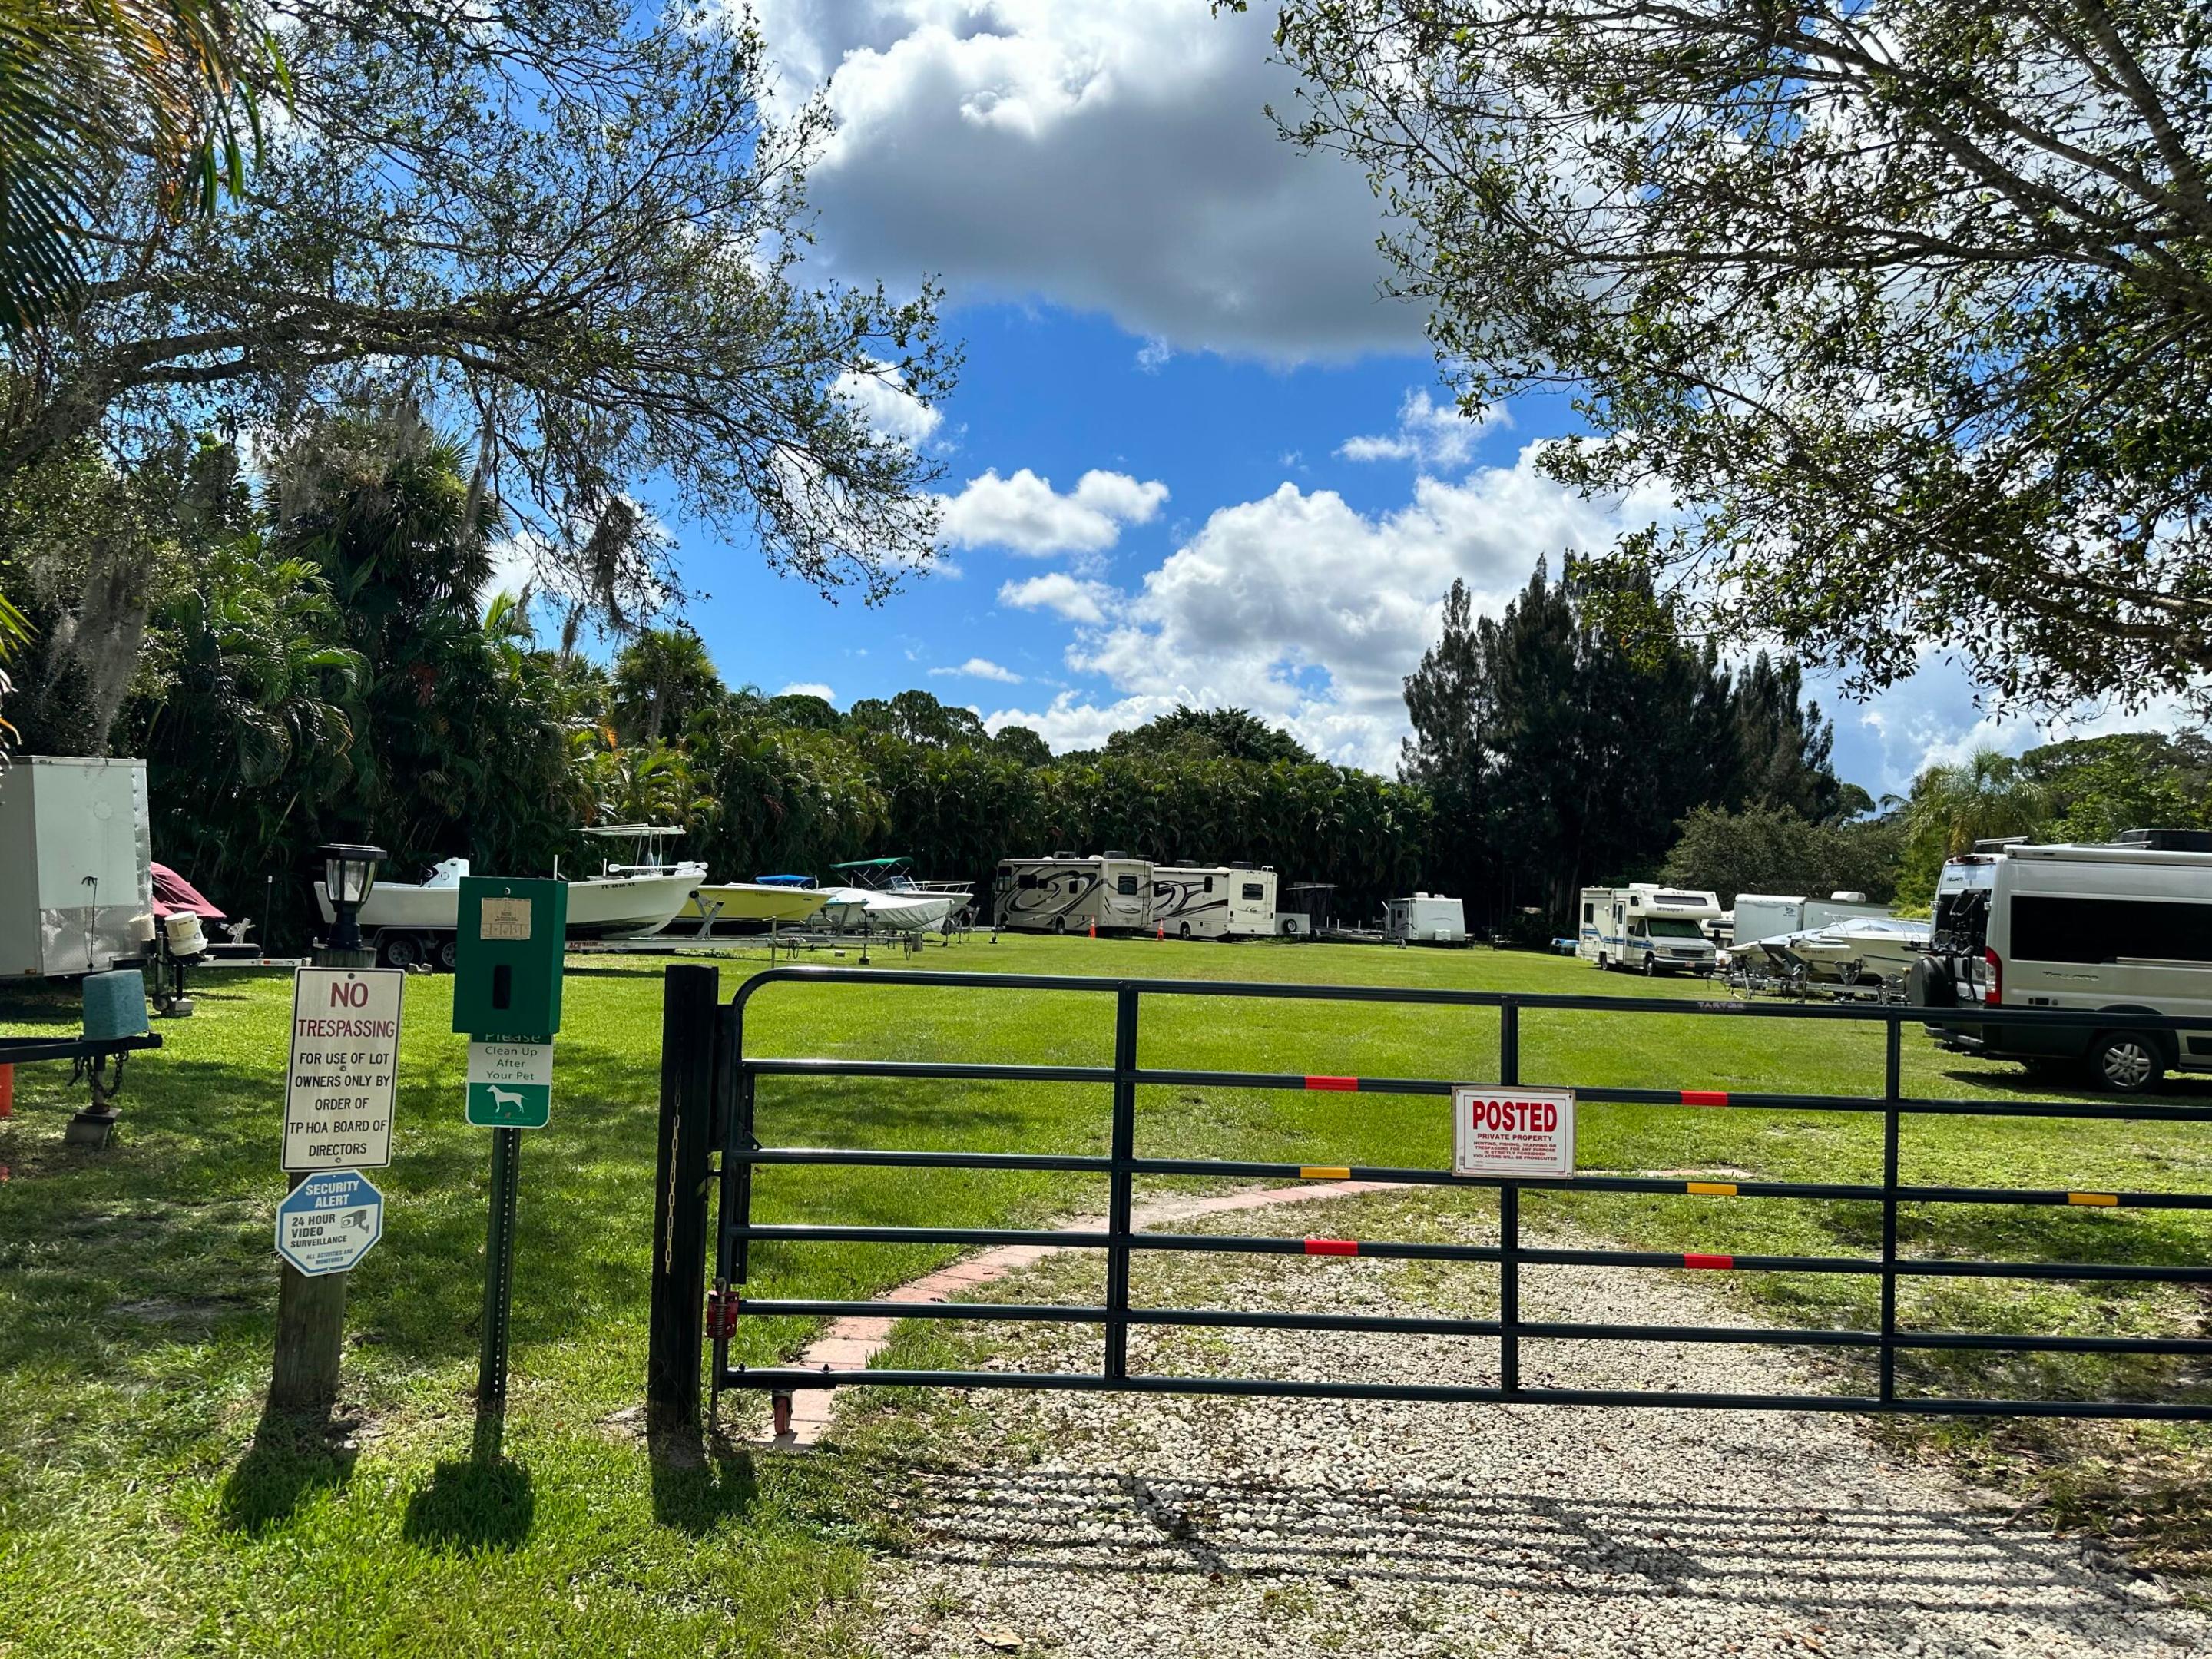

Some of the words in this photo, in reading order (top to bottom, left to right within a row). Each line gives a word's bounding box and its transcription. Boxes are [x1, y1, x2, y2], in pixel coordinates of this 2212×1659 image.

[330, 982, 369, 1008] NO
[298, 1019, 395, 1038] TRESPASSING
[485, 1046, 518, 1055] Clean
[522, 1047, 538, 1057] Up
[300, 1053, 322, 1065] FOR
[326, 1053, 347, 1065] USE
[350, 1053, 366, 1064] OF
[369, 1053, 389, 1065] LOT
[496, 1059, 526, 1068] After
[295, 1075, 341, 1088] OWNERS
[344, 1075, 372, 1087] ONLY
[376, 1075, 390, 1087] BY
[486, 1071, 512, 1079] Your
[516, 1071, 535, 1081] Pet
[315, 1098, 351, 1111] ORDER
[354, 1098, 369, 1109] OF
[1472, 1101, 1558, 1132] POSTED
[290, 1122, 304, 1134] TP
[306, 1121, 328, 1134] HOA
[333, 1121, 369, 1133] BOARD
[373, 1120, 388, 1131] OF
[309, 1143, 367, 1157] DIRECTORS
[305, 1180, 360, 1196] SECURITY
[314, 1194, 349, 1209] ALERT
[292, 1217, 305, 1227] 24
[308, 1214, 336, 1226] HOUR
[291, 1227, 323, 1238] VIDEO
[290, 1235, 348, 1248] SURVEILLANCE
